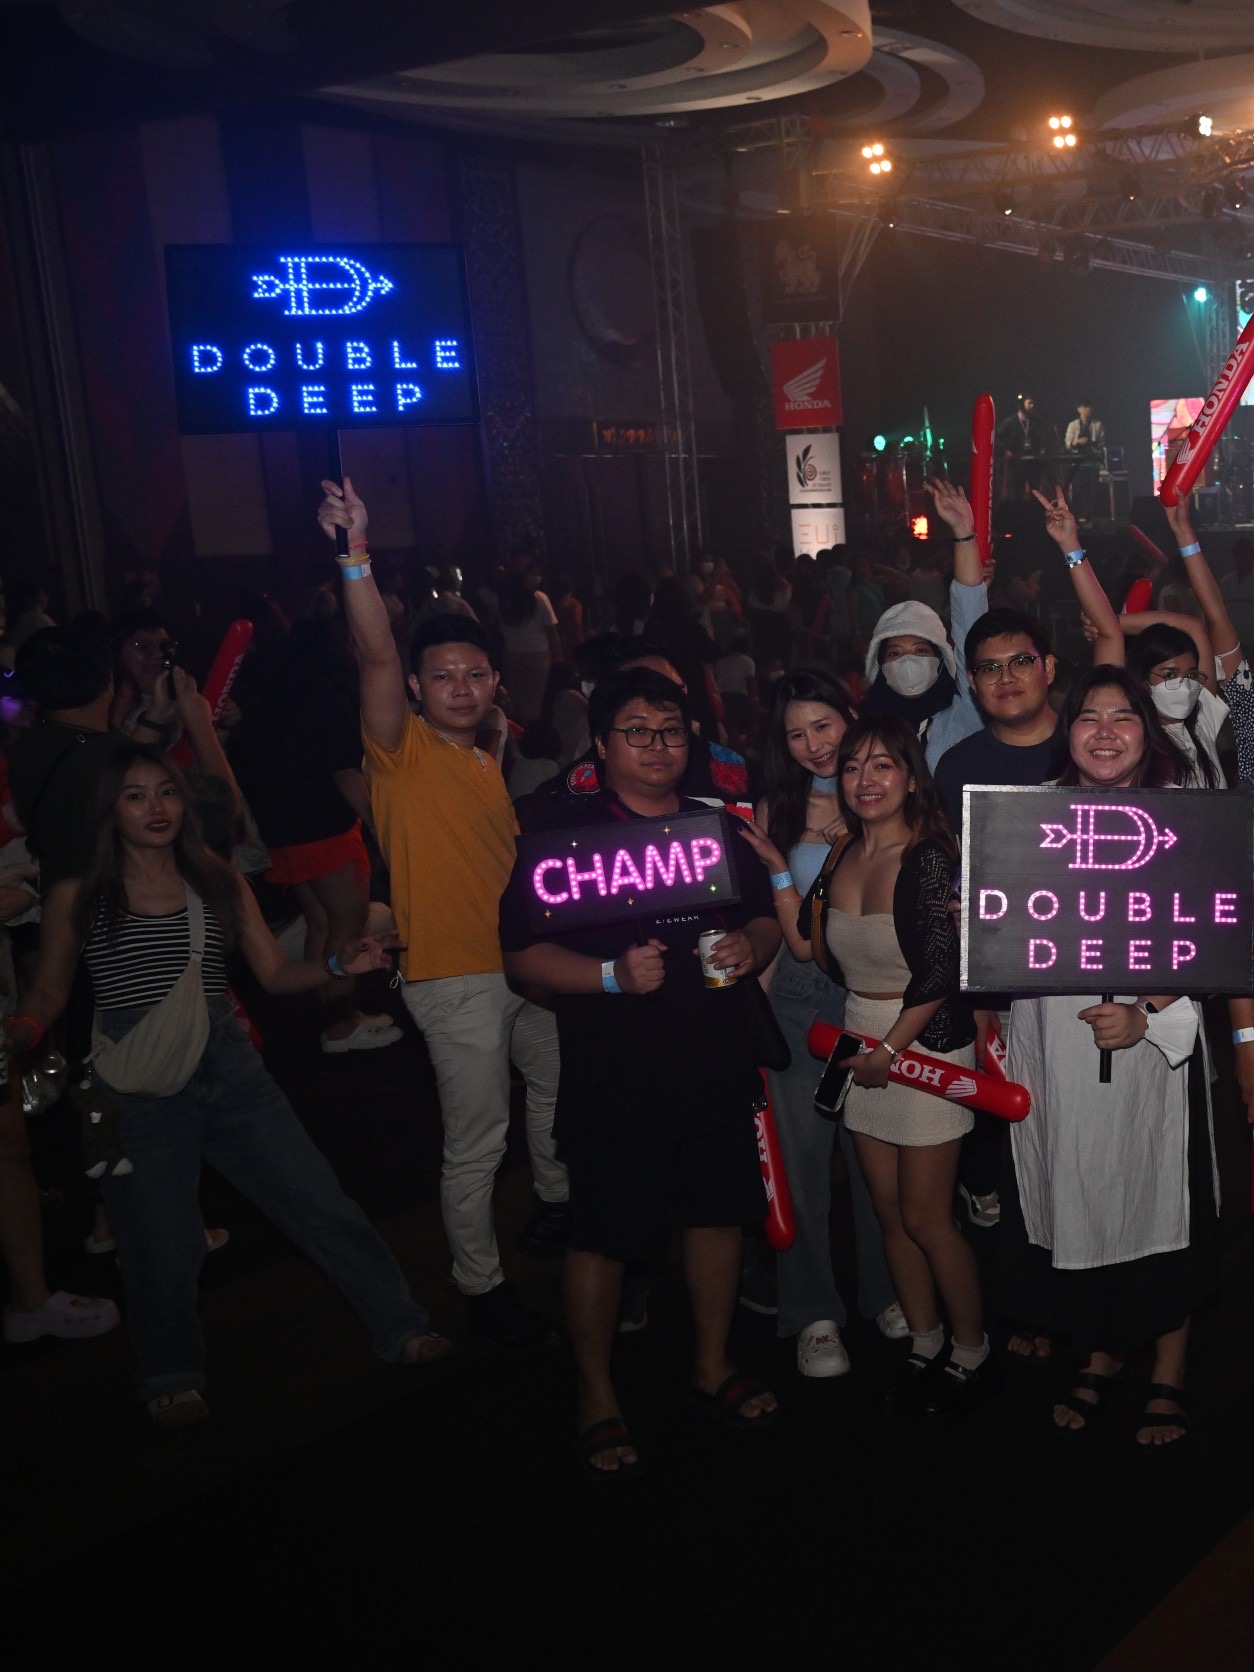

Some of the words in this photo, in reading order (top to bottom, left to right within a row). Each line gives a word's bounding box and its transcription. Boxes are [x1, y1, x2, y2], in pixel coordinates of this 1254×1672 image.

[192, 340, 460, 373] DOUBLE
[249, 383, 423, 416] DEEP
[784, 400, 832, 411] HONDA
[1192, 341, 1250, 437] HONDA
[533, 837, 722, 904] CHAMP
[979, 889, 1237, 923] DOUBLE
[1028, 939, 1197, 970] DEEP
